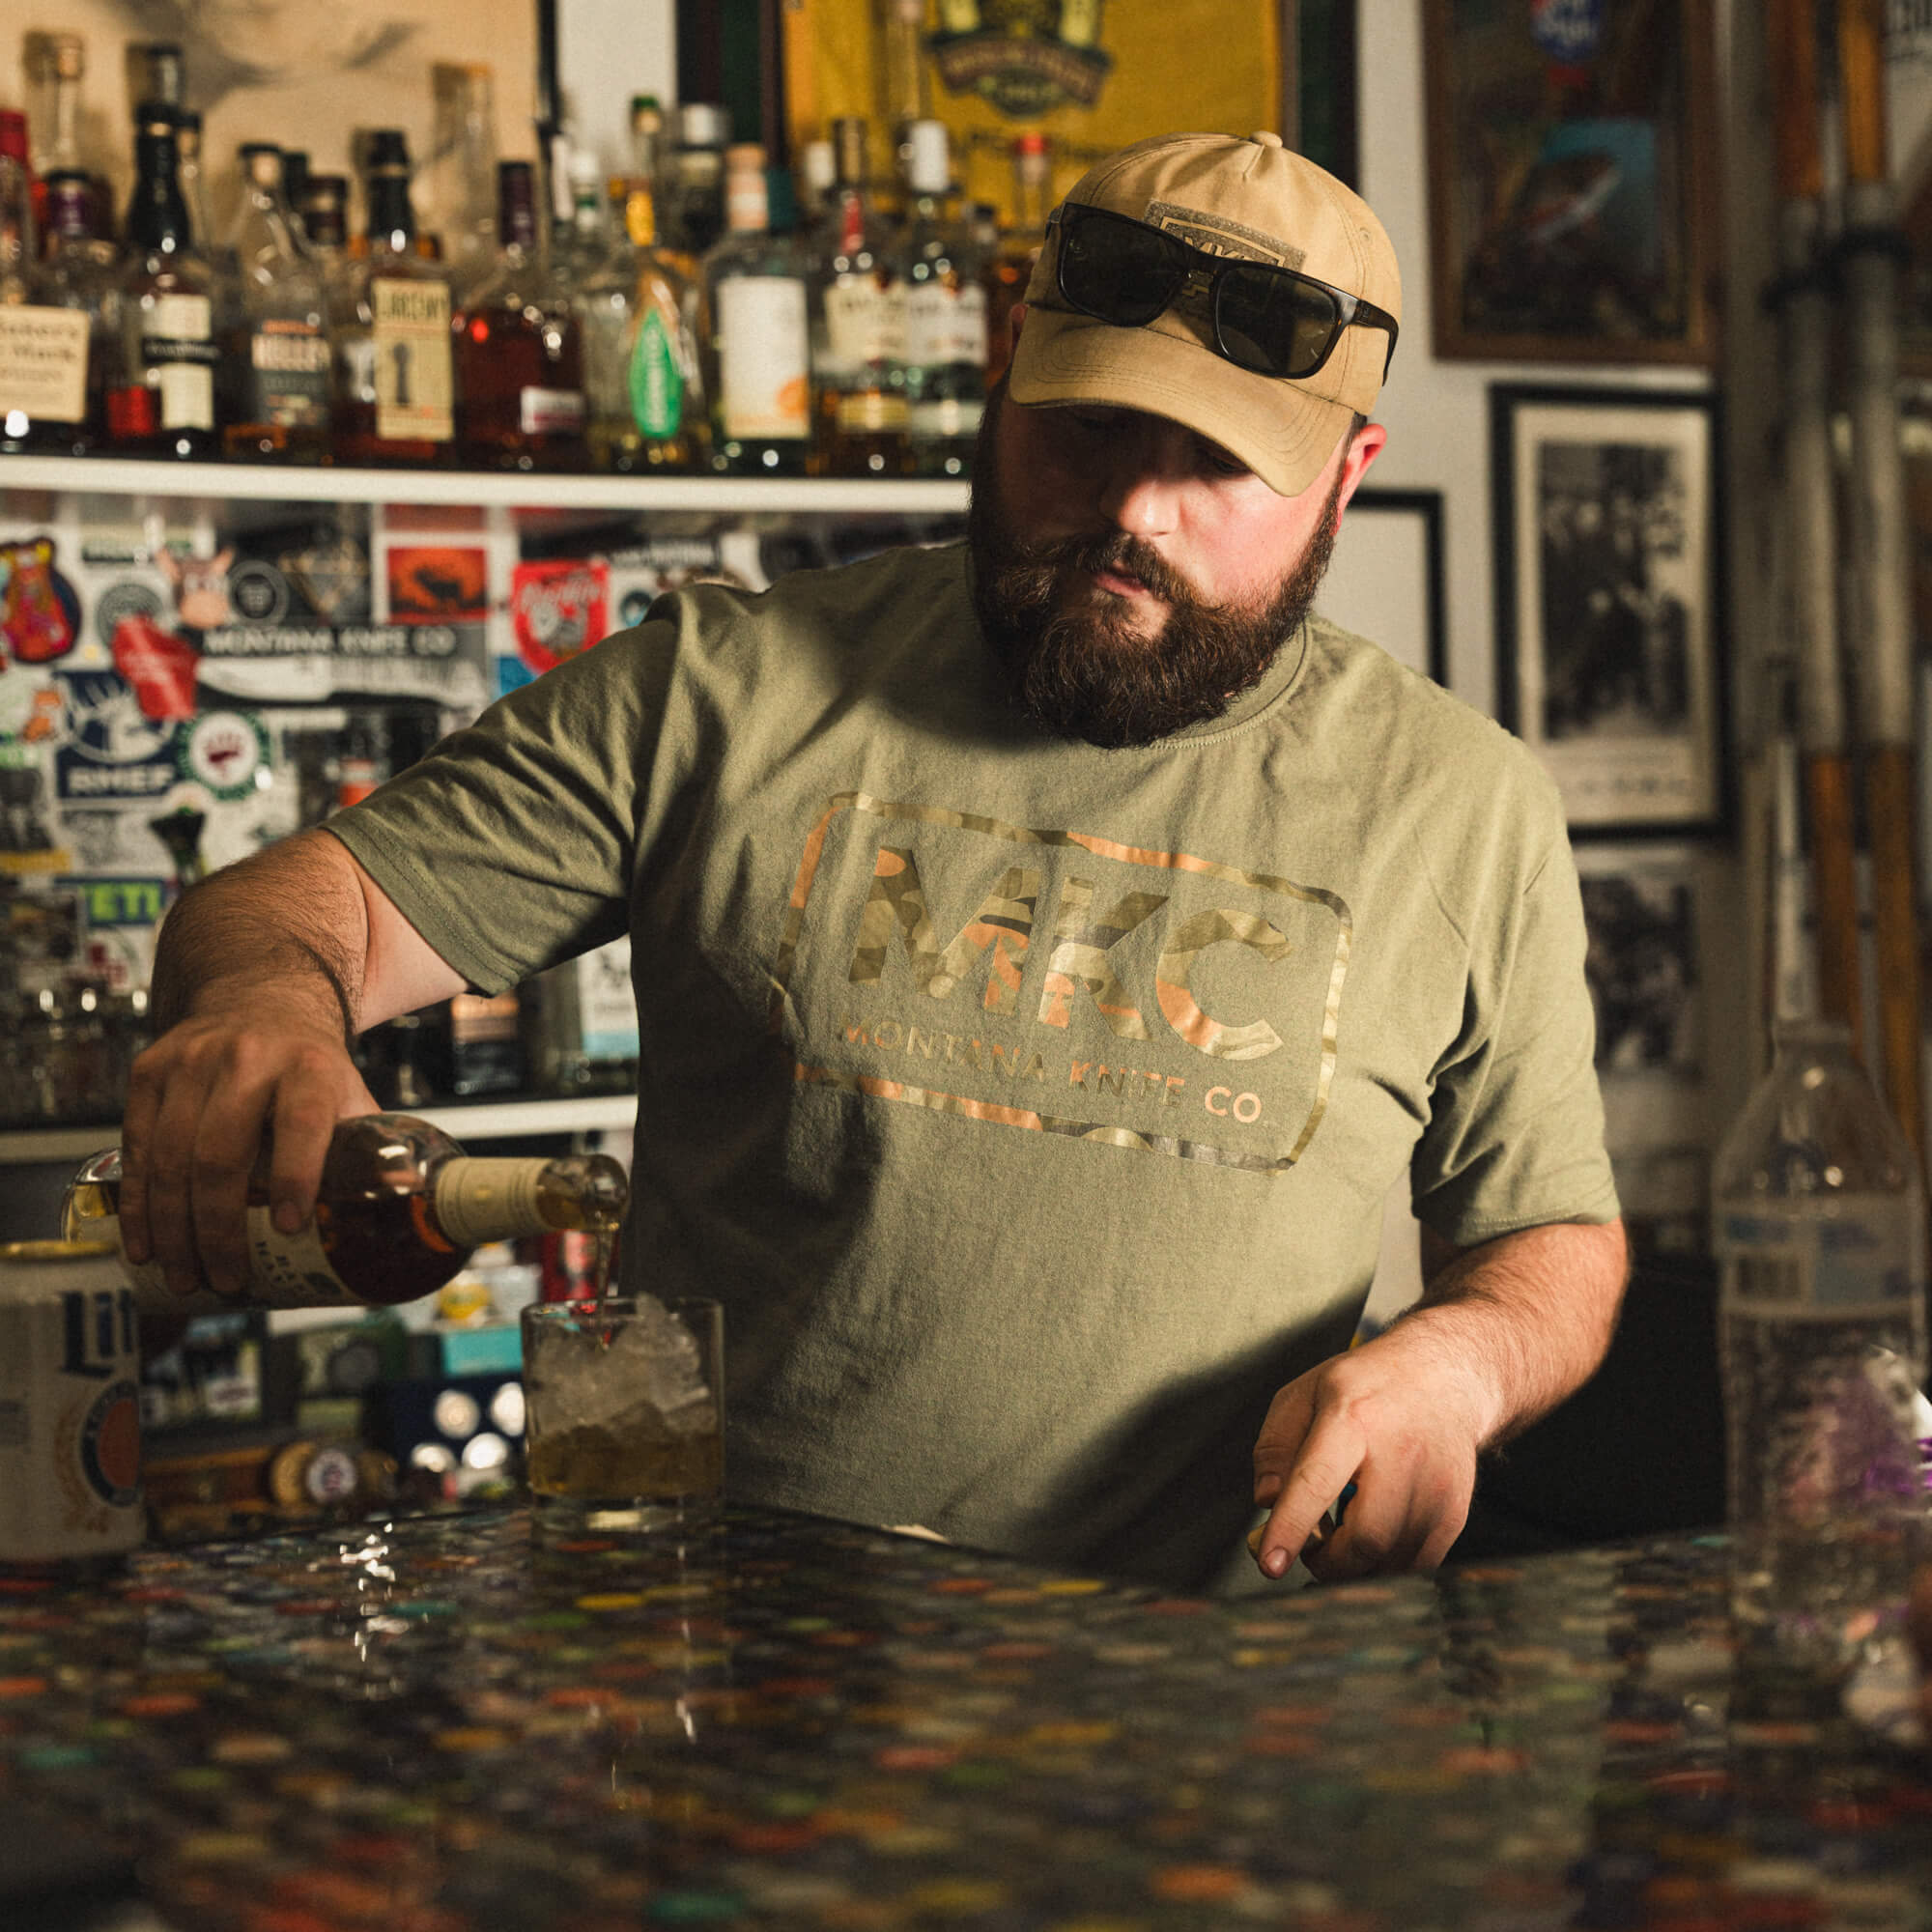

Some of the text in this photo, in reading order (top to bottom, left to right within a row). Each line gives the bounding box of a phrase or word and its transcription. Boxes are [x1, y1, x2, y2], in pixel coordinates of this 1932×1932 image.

[203, 626, 456, 657] MONTANA KNIFE CO
[848, 846, 1293, 1061] MKC
[839, 1014, 1262, 1123] MONTANA KNIFE CO
